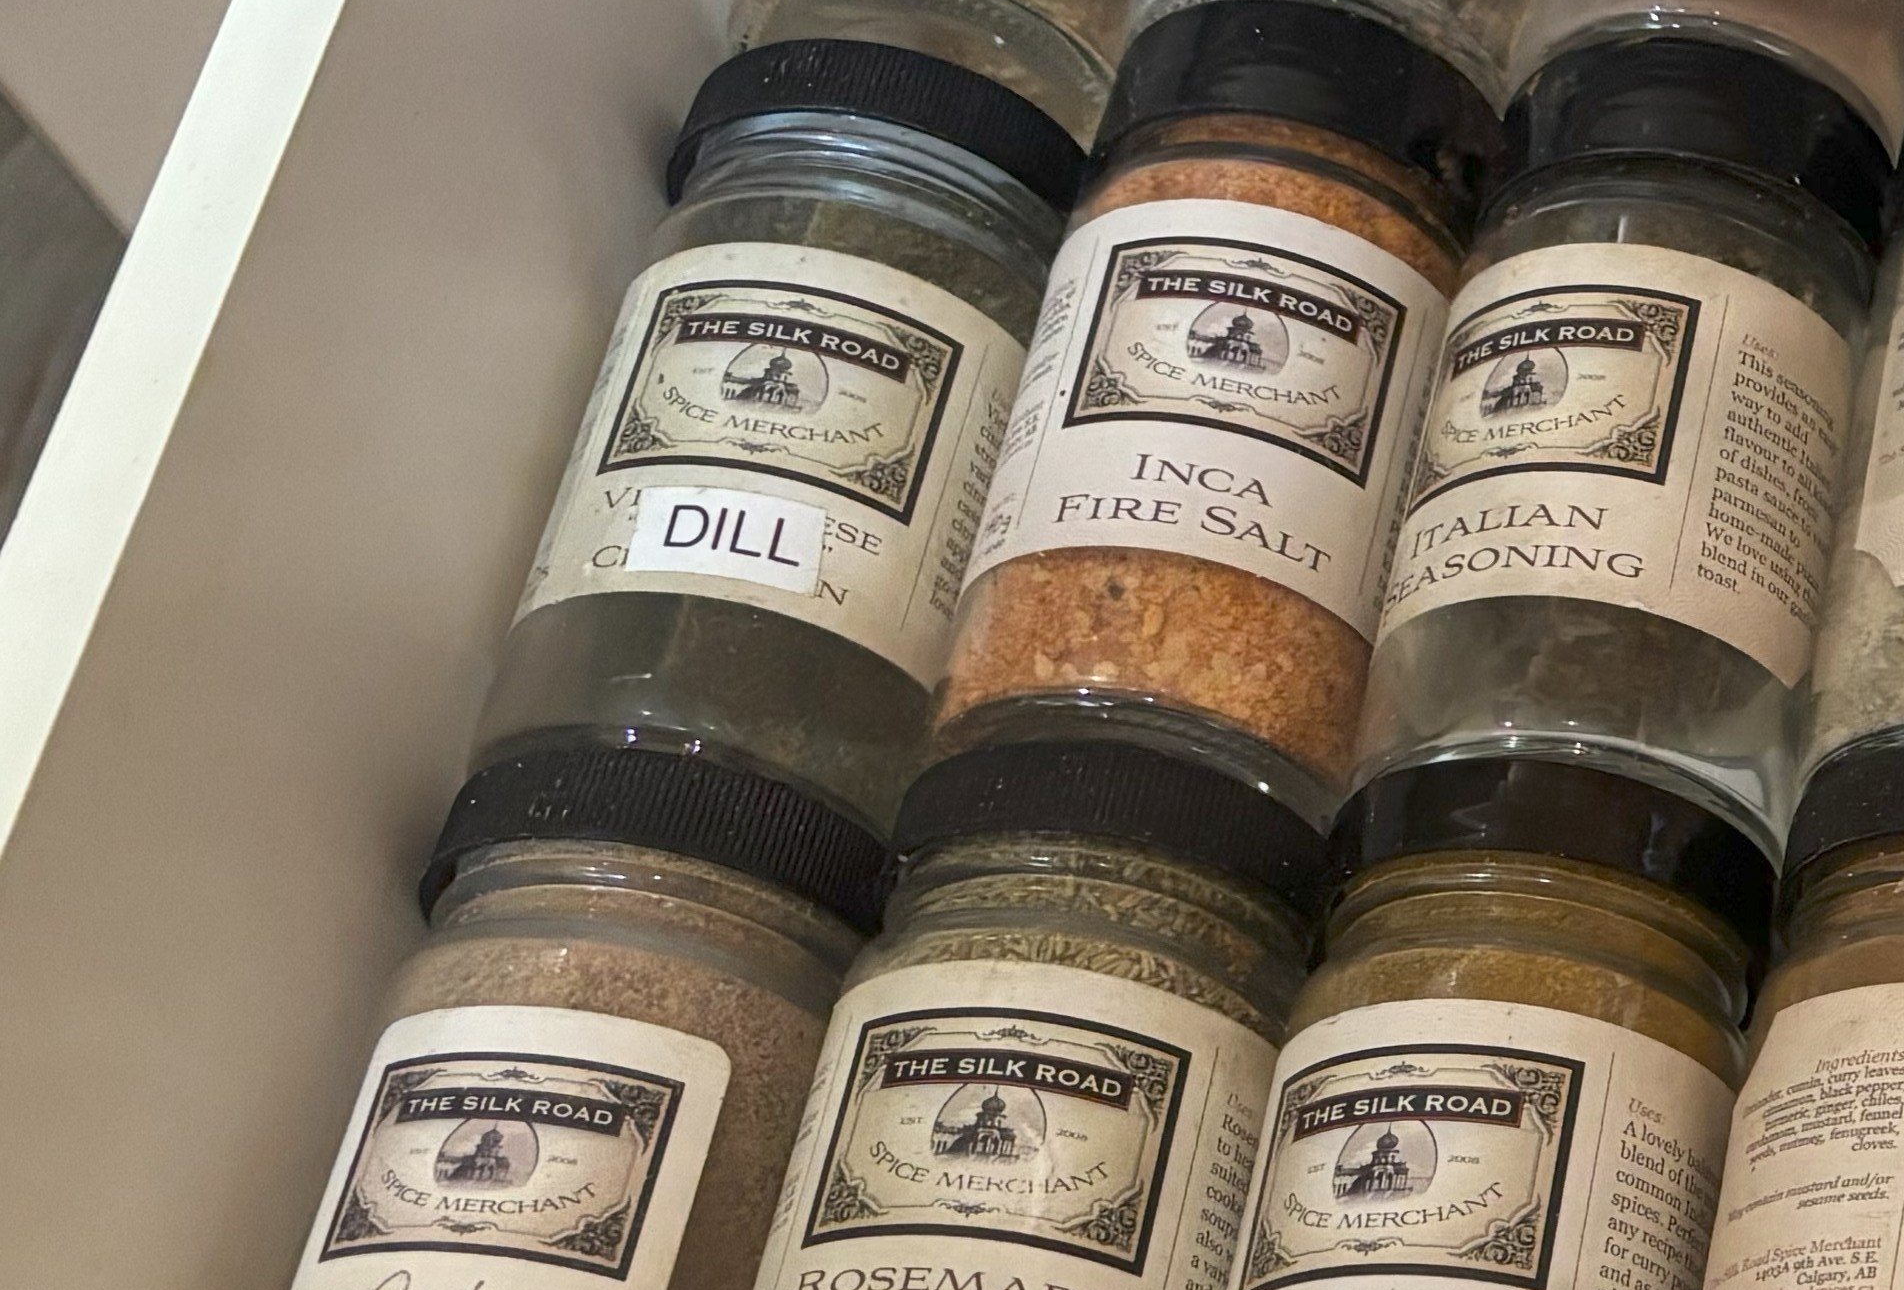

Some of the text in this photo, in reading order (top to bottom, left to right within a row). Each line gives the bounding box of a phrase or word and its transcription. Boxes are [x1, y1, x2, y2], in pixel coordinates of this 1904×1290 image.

[1129, 453, 1273, 508] INCA
[662, 504, 800, 568] DILL
[1053, 493, 1332, 573] FIRE SALT
[1411, 504, 1609, 561] ITALIAN
[407, 1096, 613, 1126] THE SILK ROAD
[382, 1169, 597, 1215] SPICE MERCHANT
